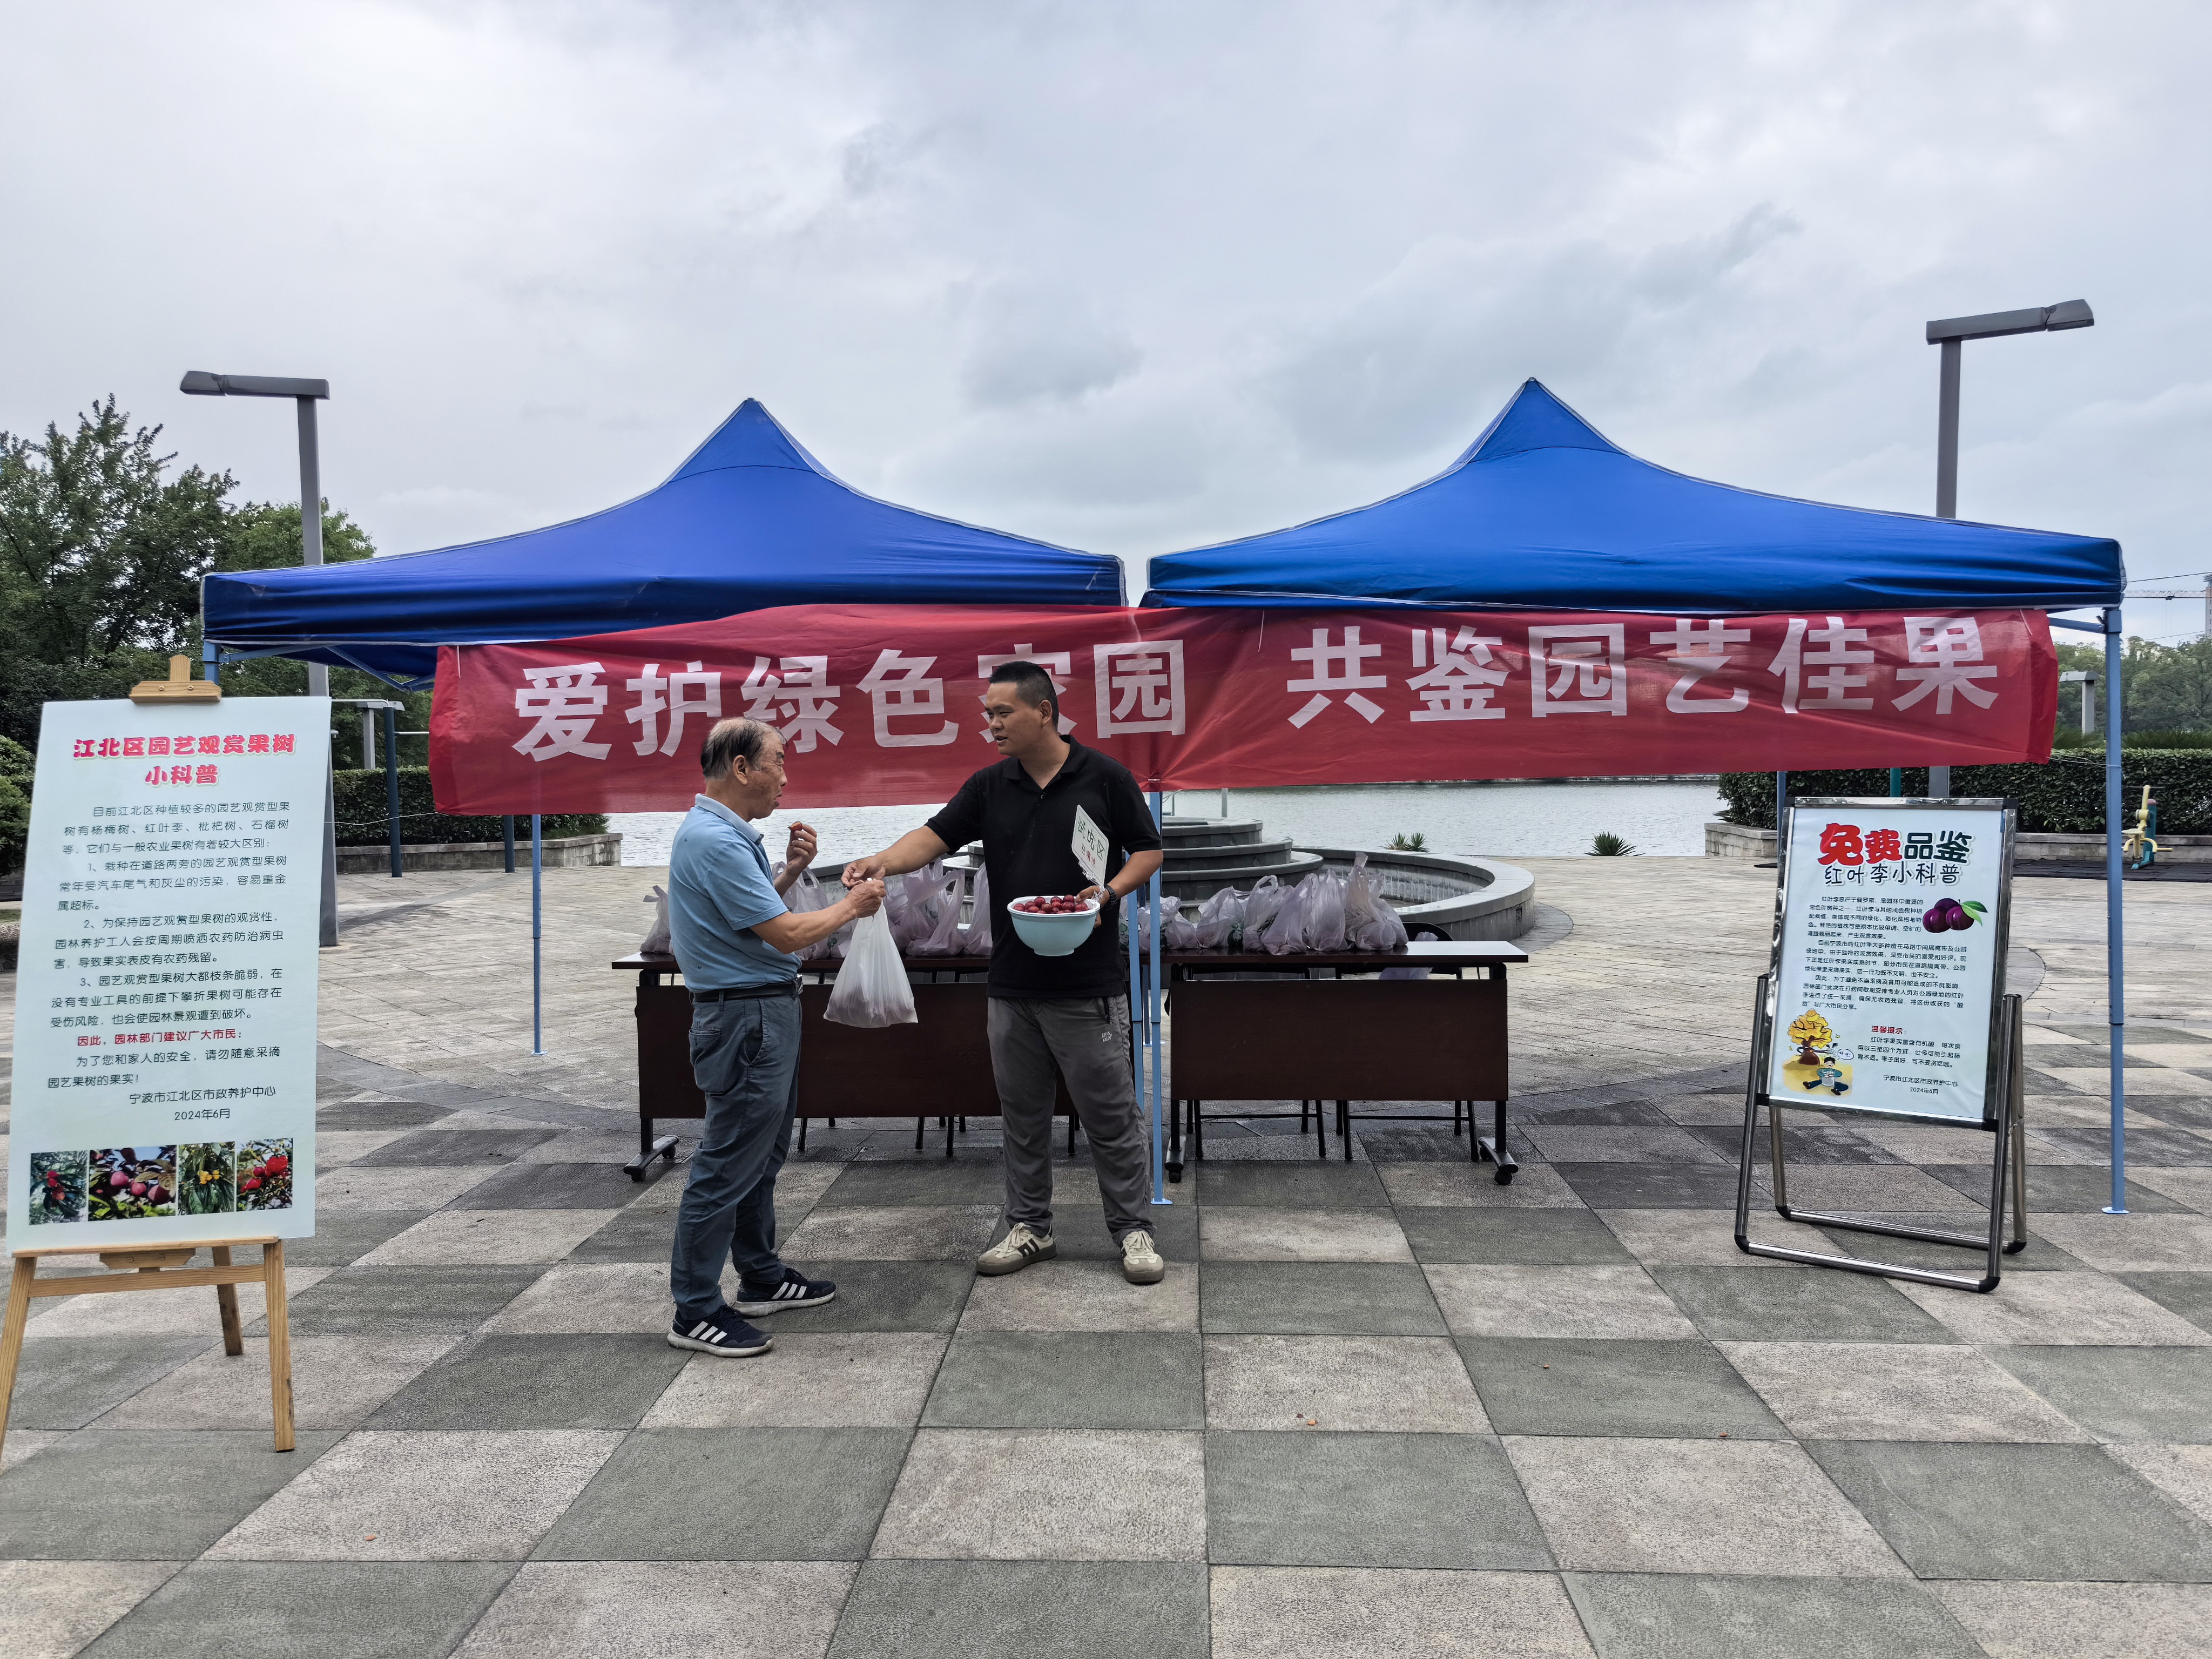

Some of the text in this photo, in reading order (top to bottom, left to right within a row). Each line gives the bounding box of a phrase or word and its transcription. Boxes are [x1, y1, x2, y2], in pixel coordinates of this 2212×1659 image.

[1286, 616, 2000, 729] 共鉴园艺佳果
[73, 734, 295, 758] 江北区园艺观赏果树
[145, 765, 219, 785] 小科普
[93, 801, 290, 817] 目前江北区种植较多的园艺观赏型果
[64, 819, 289, 837] 树有杨梅树、红叶李、枇杷树、石榴树
[1817, 822, 1972, 866] 免费品鉴
[88, 855, 287, 871] 1、栽种在道路两旁的园艺观赏型果树
[1825, 861, 1959, 884] 红叶李小科普
[59, 874, 286, 892] 常年受汽车尾气和灰尘的污染，容易重金
[57, 899, 99, 911] 属超标。
[84, 912, 278, 928] 2、为保持园艺观赏型果树的观赏性，
[55, 930, 284, 949] 园林养护工人会按周期喷洒农药防治病虫
[55, 952, 217, 969] 害，导致果实表皮有农药残留。
[80, 969, 282, 986] 3、园艺观赏型果树大都枝条脆弱，在
[51, 988, 282, 1008] 没有专业工具的前提下攀折果树可能存在
[50, 1008, 252, 1027] 受伤风险，也会使园林景观遭到破坏。
[78, 1029, 241, 1046] 因此，园林部门建议广大市民：
[76, 1047, 280, 1067] 为了您和家人的安全，请勿随意采摘
[1883, 1075, 1958, 1087] 宁波市江北区市政养护中心
[129, 1087, 276, 1104] 宁波市江北区市政养护中心
[174, 1108, 231, 1121] 2024年6月
